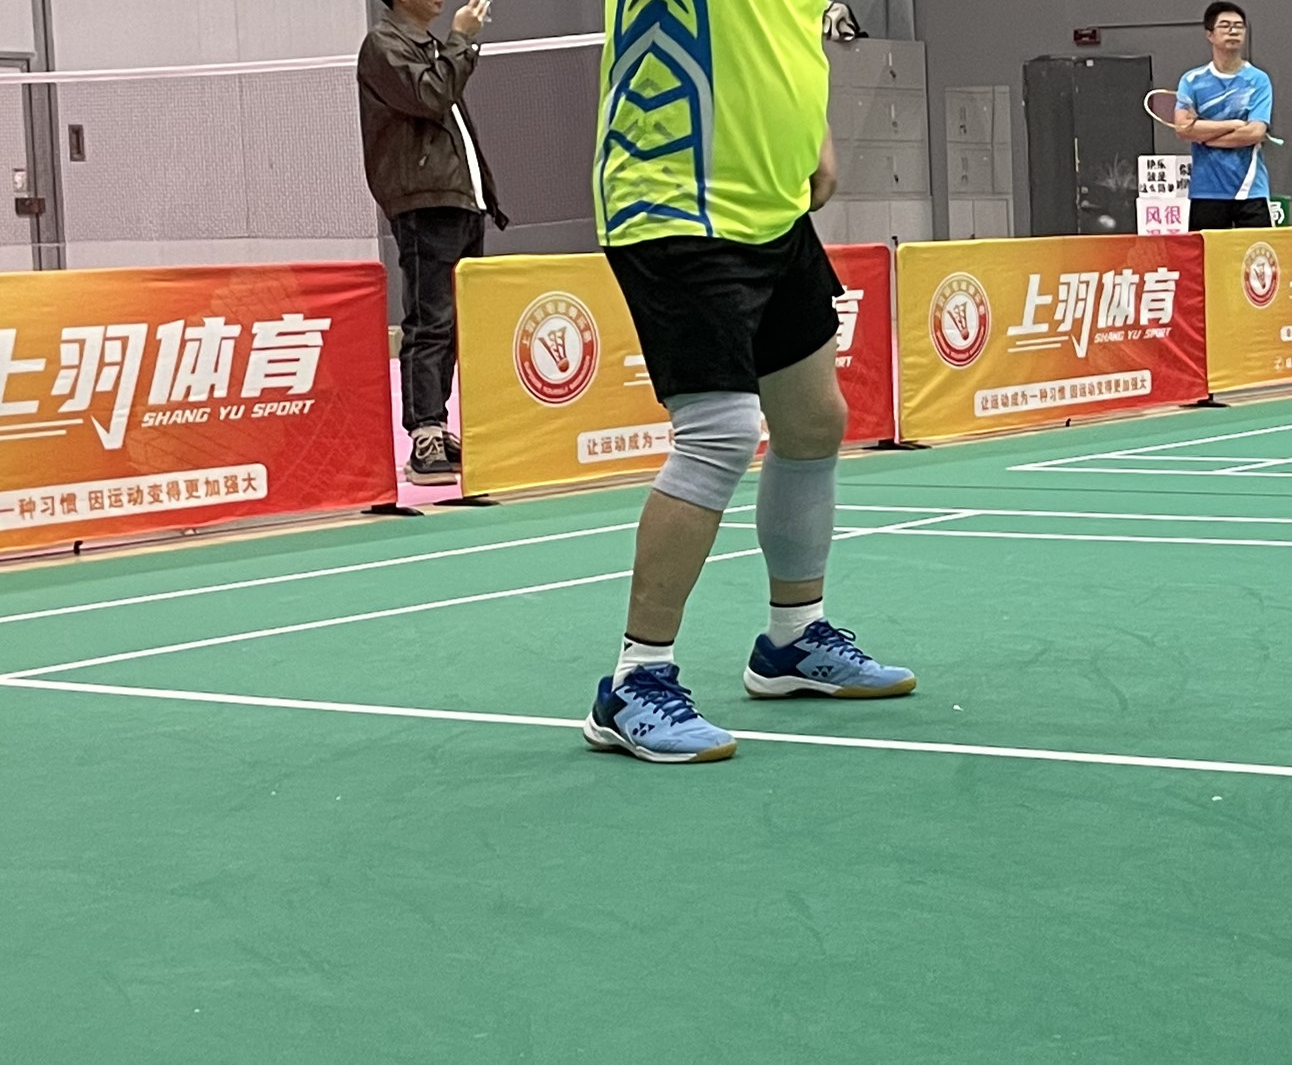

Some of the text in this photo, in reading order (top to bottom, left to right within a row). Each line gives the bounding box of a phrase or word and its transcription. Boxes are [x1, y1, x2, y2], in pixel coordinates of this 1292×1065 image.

[1145, 205, 1182, 225] 风很
[1006, 267, 1180, 358] 上羽体育
[1093, 327, 1173, 344] SHANG YU SPORT
[141, 399, 316, 428] SHANG YU SPORT
[87, 472, 259, 511] 因运动变得更加强大
